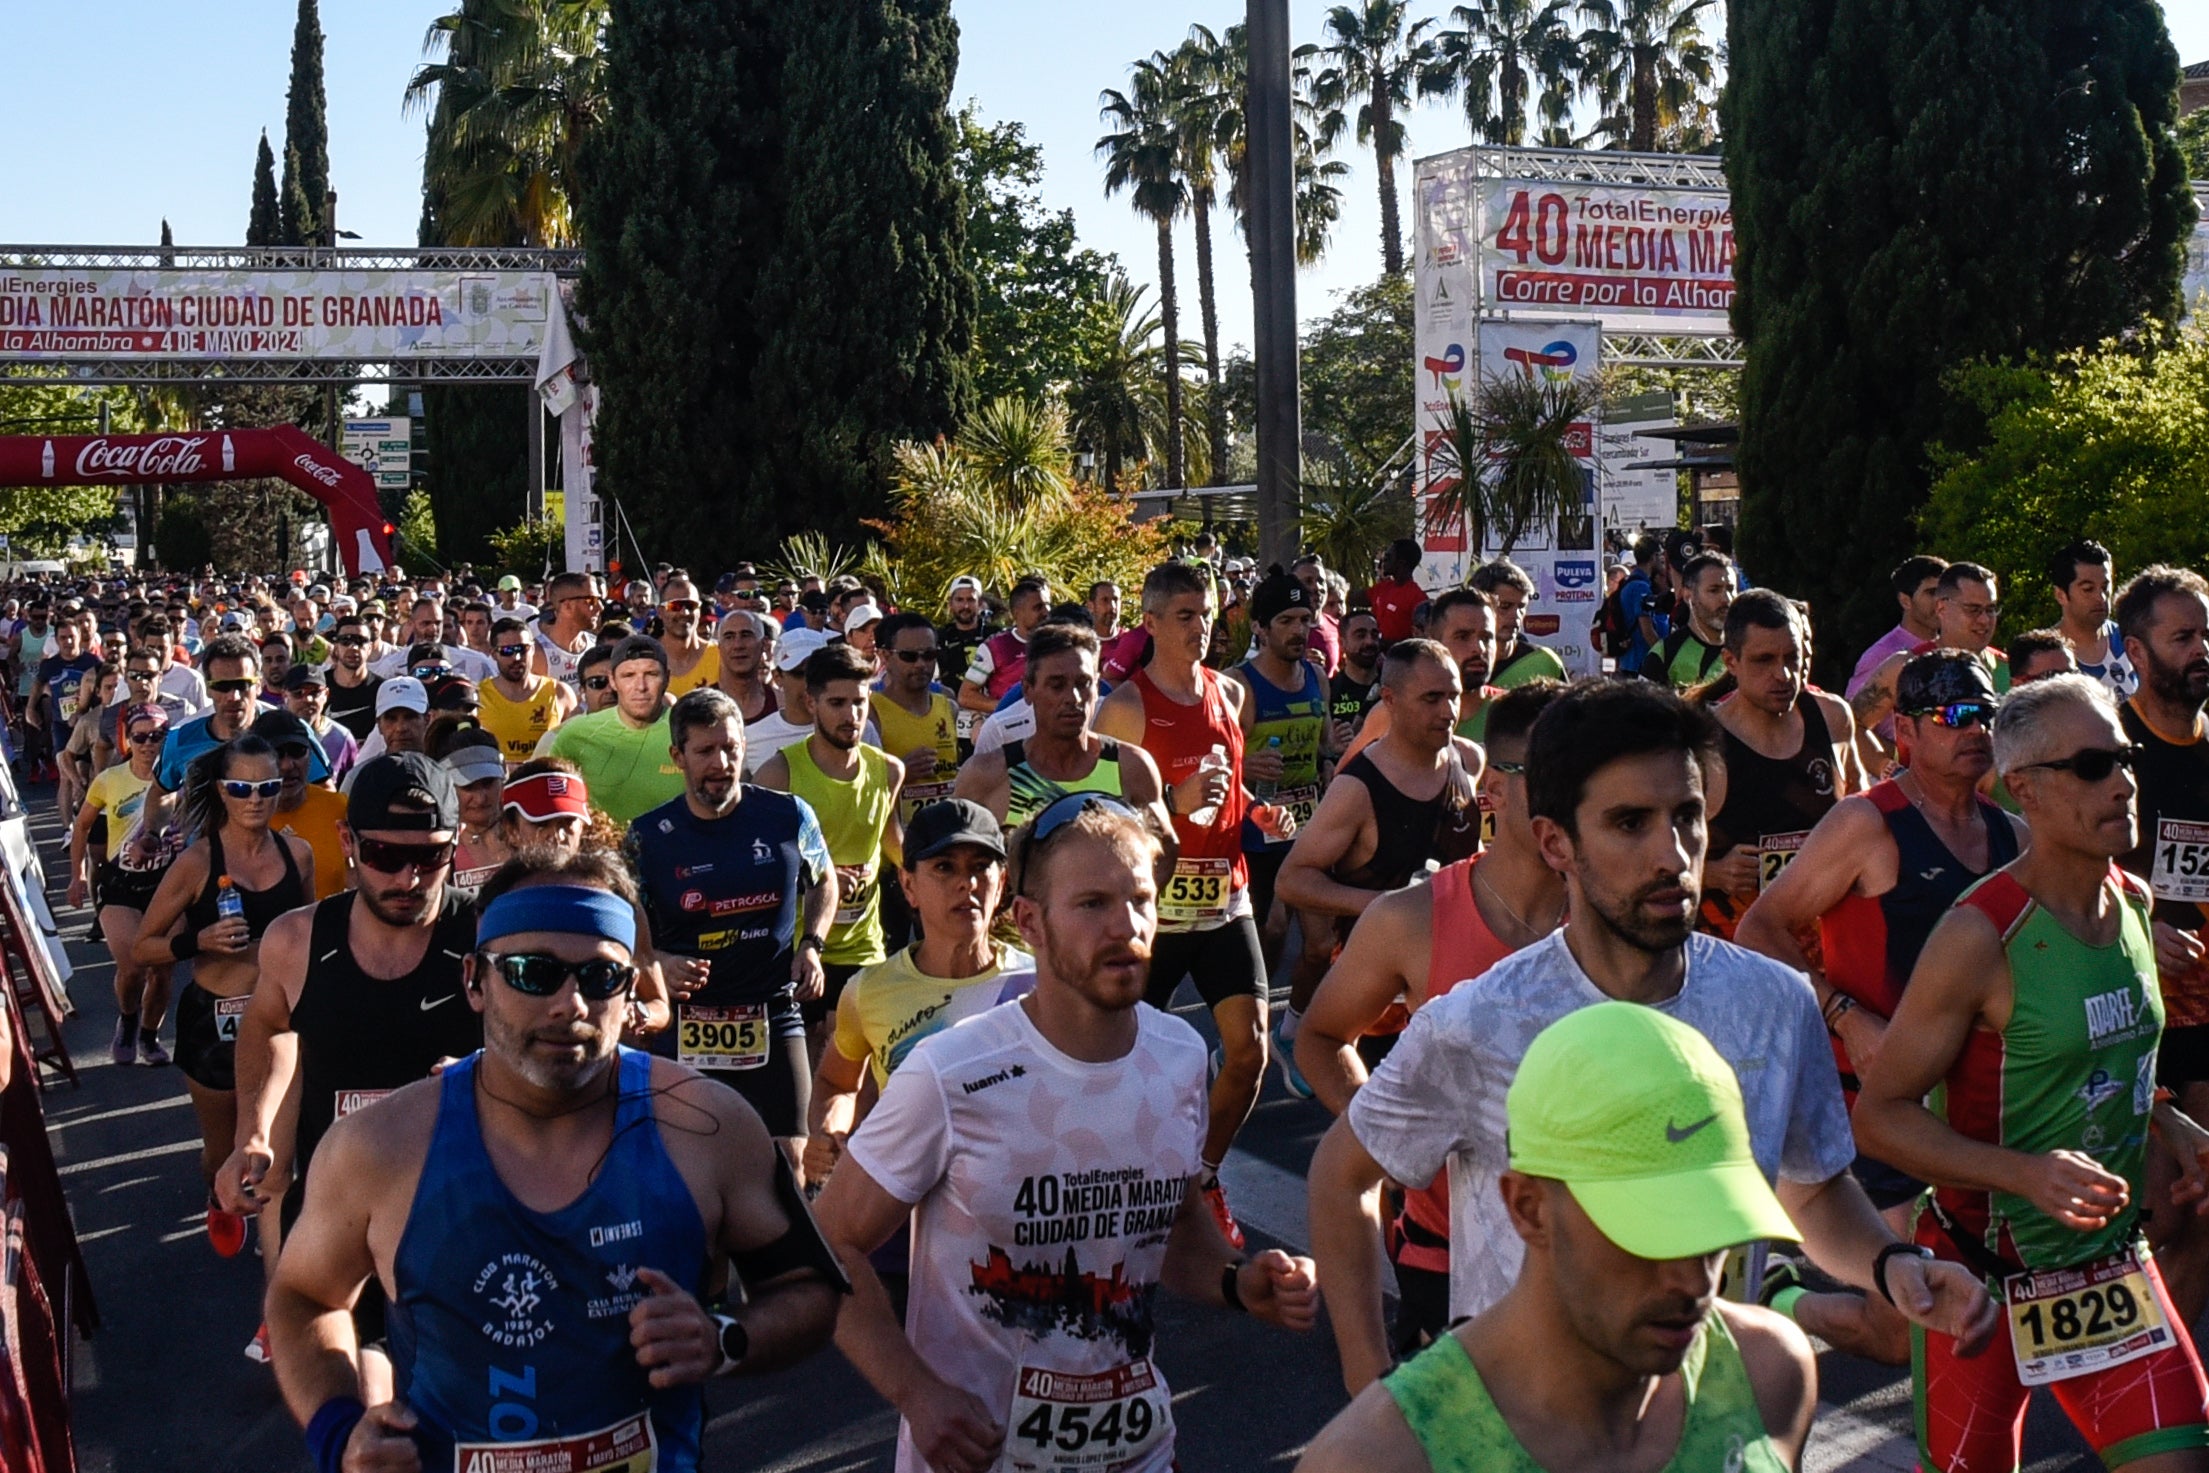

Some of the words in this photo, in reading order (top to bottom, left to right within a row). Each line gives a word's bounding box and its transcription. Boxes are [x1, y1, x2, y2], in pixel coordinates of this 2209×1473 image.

[1496, 191, 1568, 266] 40
[1576, 224, 1679, 272] MEDIA
[0, 277, 97, 297] lEnergies
[1500, 273, 1573, 300] Corre
[1581, 283, 1626, 310] por
[1634, 278, 1657, 305] la
[50, 289, 172, 327] MARATÓN
[180, 296, 274, 327] CIUDAD
[283, 296, 314, 327] DE
[322, 296, 442, 327] GRANADA
[4, 332, 24, 350] la
[29, 332, 133, 351] Alhambra
[161, 331, 173, 352] 4
[179, 331, 200, 352] DE
[205, 331, 252, 352] MAYO
[257, 331, 303, 352] 2024
[76, 437, 208, 476] Coca-Cola
[294, 453, 343, 487] Coca-Cola
[1557, 567, 1592, 577] PULEVA
[1333, 701, 1361, 715] 2503
[1286, 802, 1313, 823] 29
[715, 893, 779, 911] PETROSOL
[740, 928, 769, 940] bike
[2084, 986, 2135, 1040] ATARFE
[683, 1022, 756, 1049] 3905
[962, 1069, 1010, 1095] luanvi
[341, 1093, 361, 1115] 40
[1063, 1166, 1144, 1187] TotalEnergies
[1014, 1175, 1059, 1219] 40
[1062, 1181, 1122, 1215] MEDIA
[1014, 1216, 1090, 1247] CIUDAD
[1094, 1212, 1120, 1240] DE
[473, 1261, 498, 1293] CLUB
[505, 1319, 533, 1332] 1989
[2020, 1283, 2137, 1345] 1829
[482, 1319, 555, 1347] BADAJOZ
[1026, 1370, 1053, 1397] 40
[1017, 1397, 1153, 1451] 4549
[466, 1451, 497, 1473] 40
[496, 1455, 524, 1472] MEDIA
[526, 1449, 572, 1468] MARATÓN
[593, 1449, 614, 1464] MAYO
